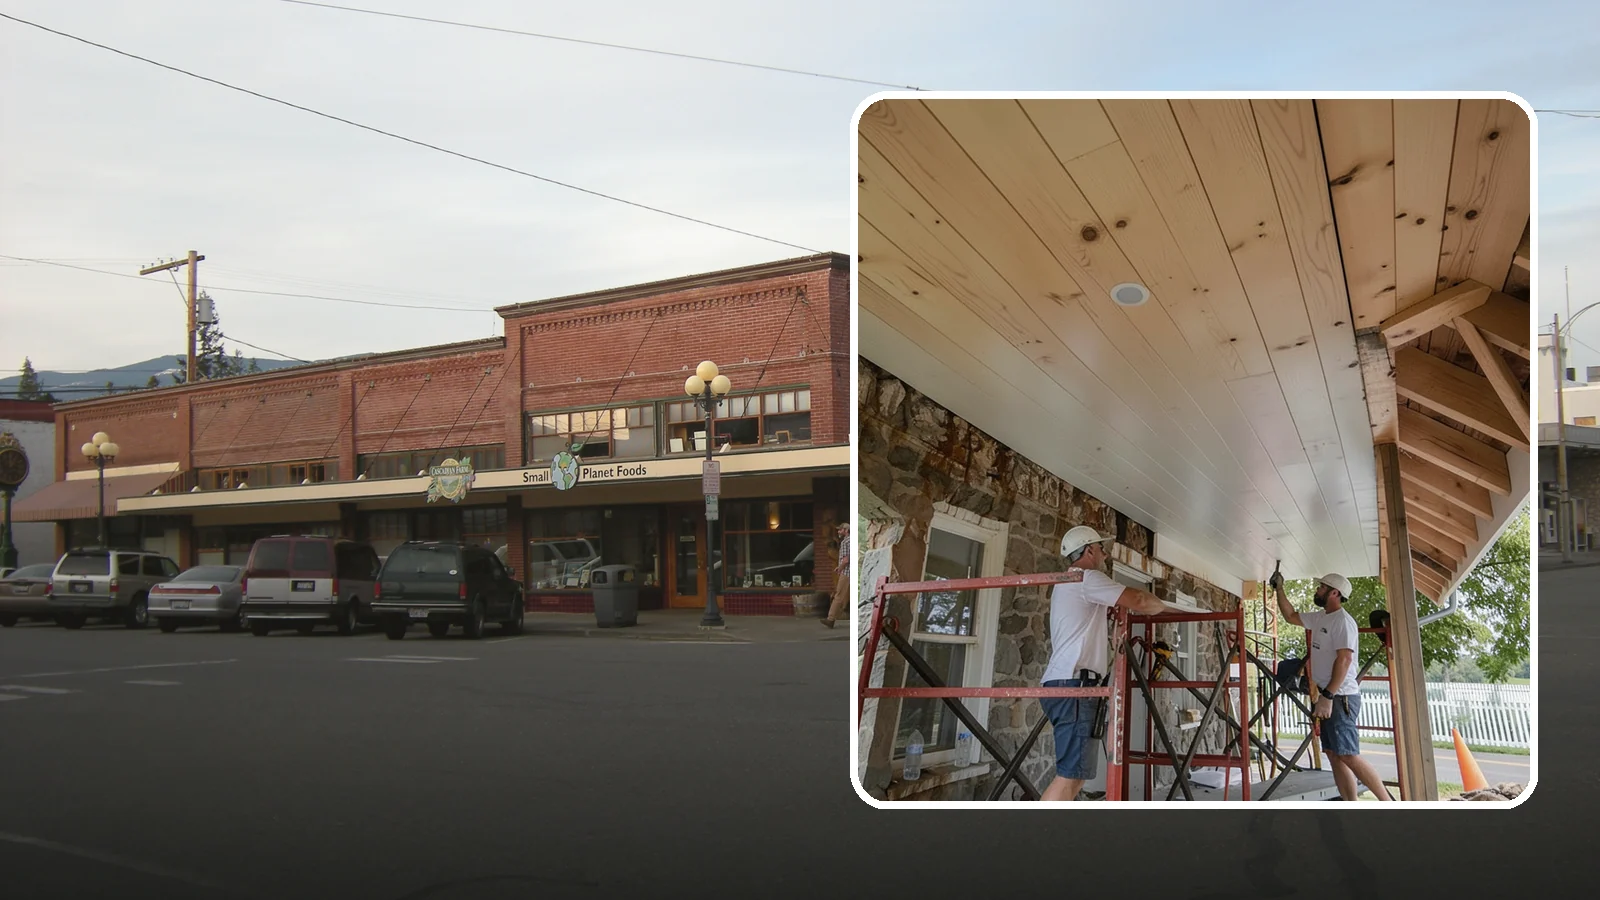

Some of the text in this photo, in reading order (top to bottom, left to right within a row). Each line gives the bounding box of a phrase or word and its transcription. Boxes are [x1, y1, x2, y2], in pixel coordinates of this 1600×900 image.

[522, 464, 647, 483] Small Planet Foods
